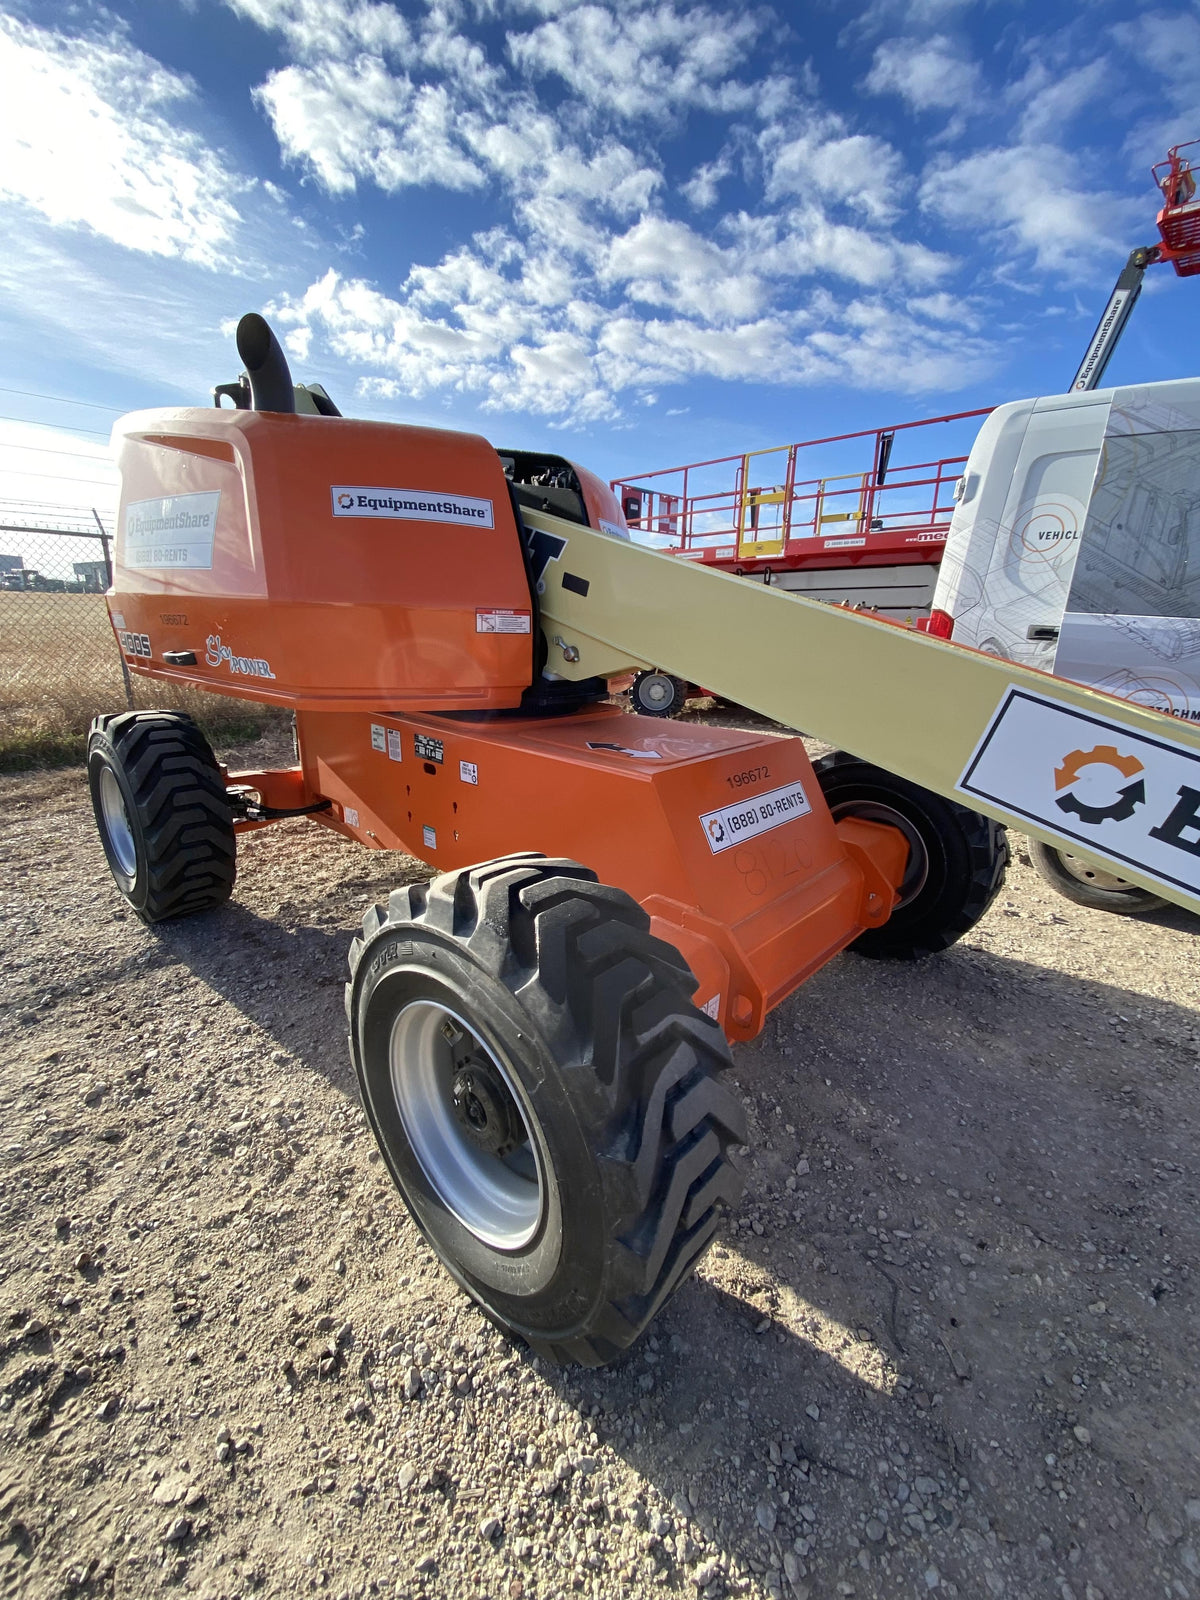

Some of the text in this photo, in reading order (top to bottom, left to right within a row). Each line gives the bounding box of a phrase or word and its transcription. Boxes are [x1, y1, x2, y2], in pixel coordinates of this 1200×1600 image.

[1081, 300, 1122, 379] EquipmentShare
[357, 495, 485, 518] EquipmentShare
[135, 512, 210, 536] EquipmentShare
[160, 614, 189, 625] 196672
[726, 766, 771, 789] 196672
[727, 792, 804, 834] (888) 80-RENTS
